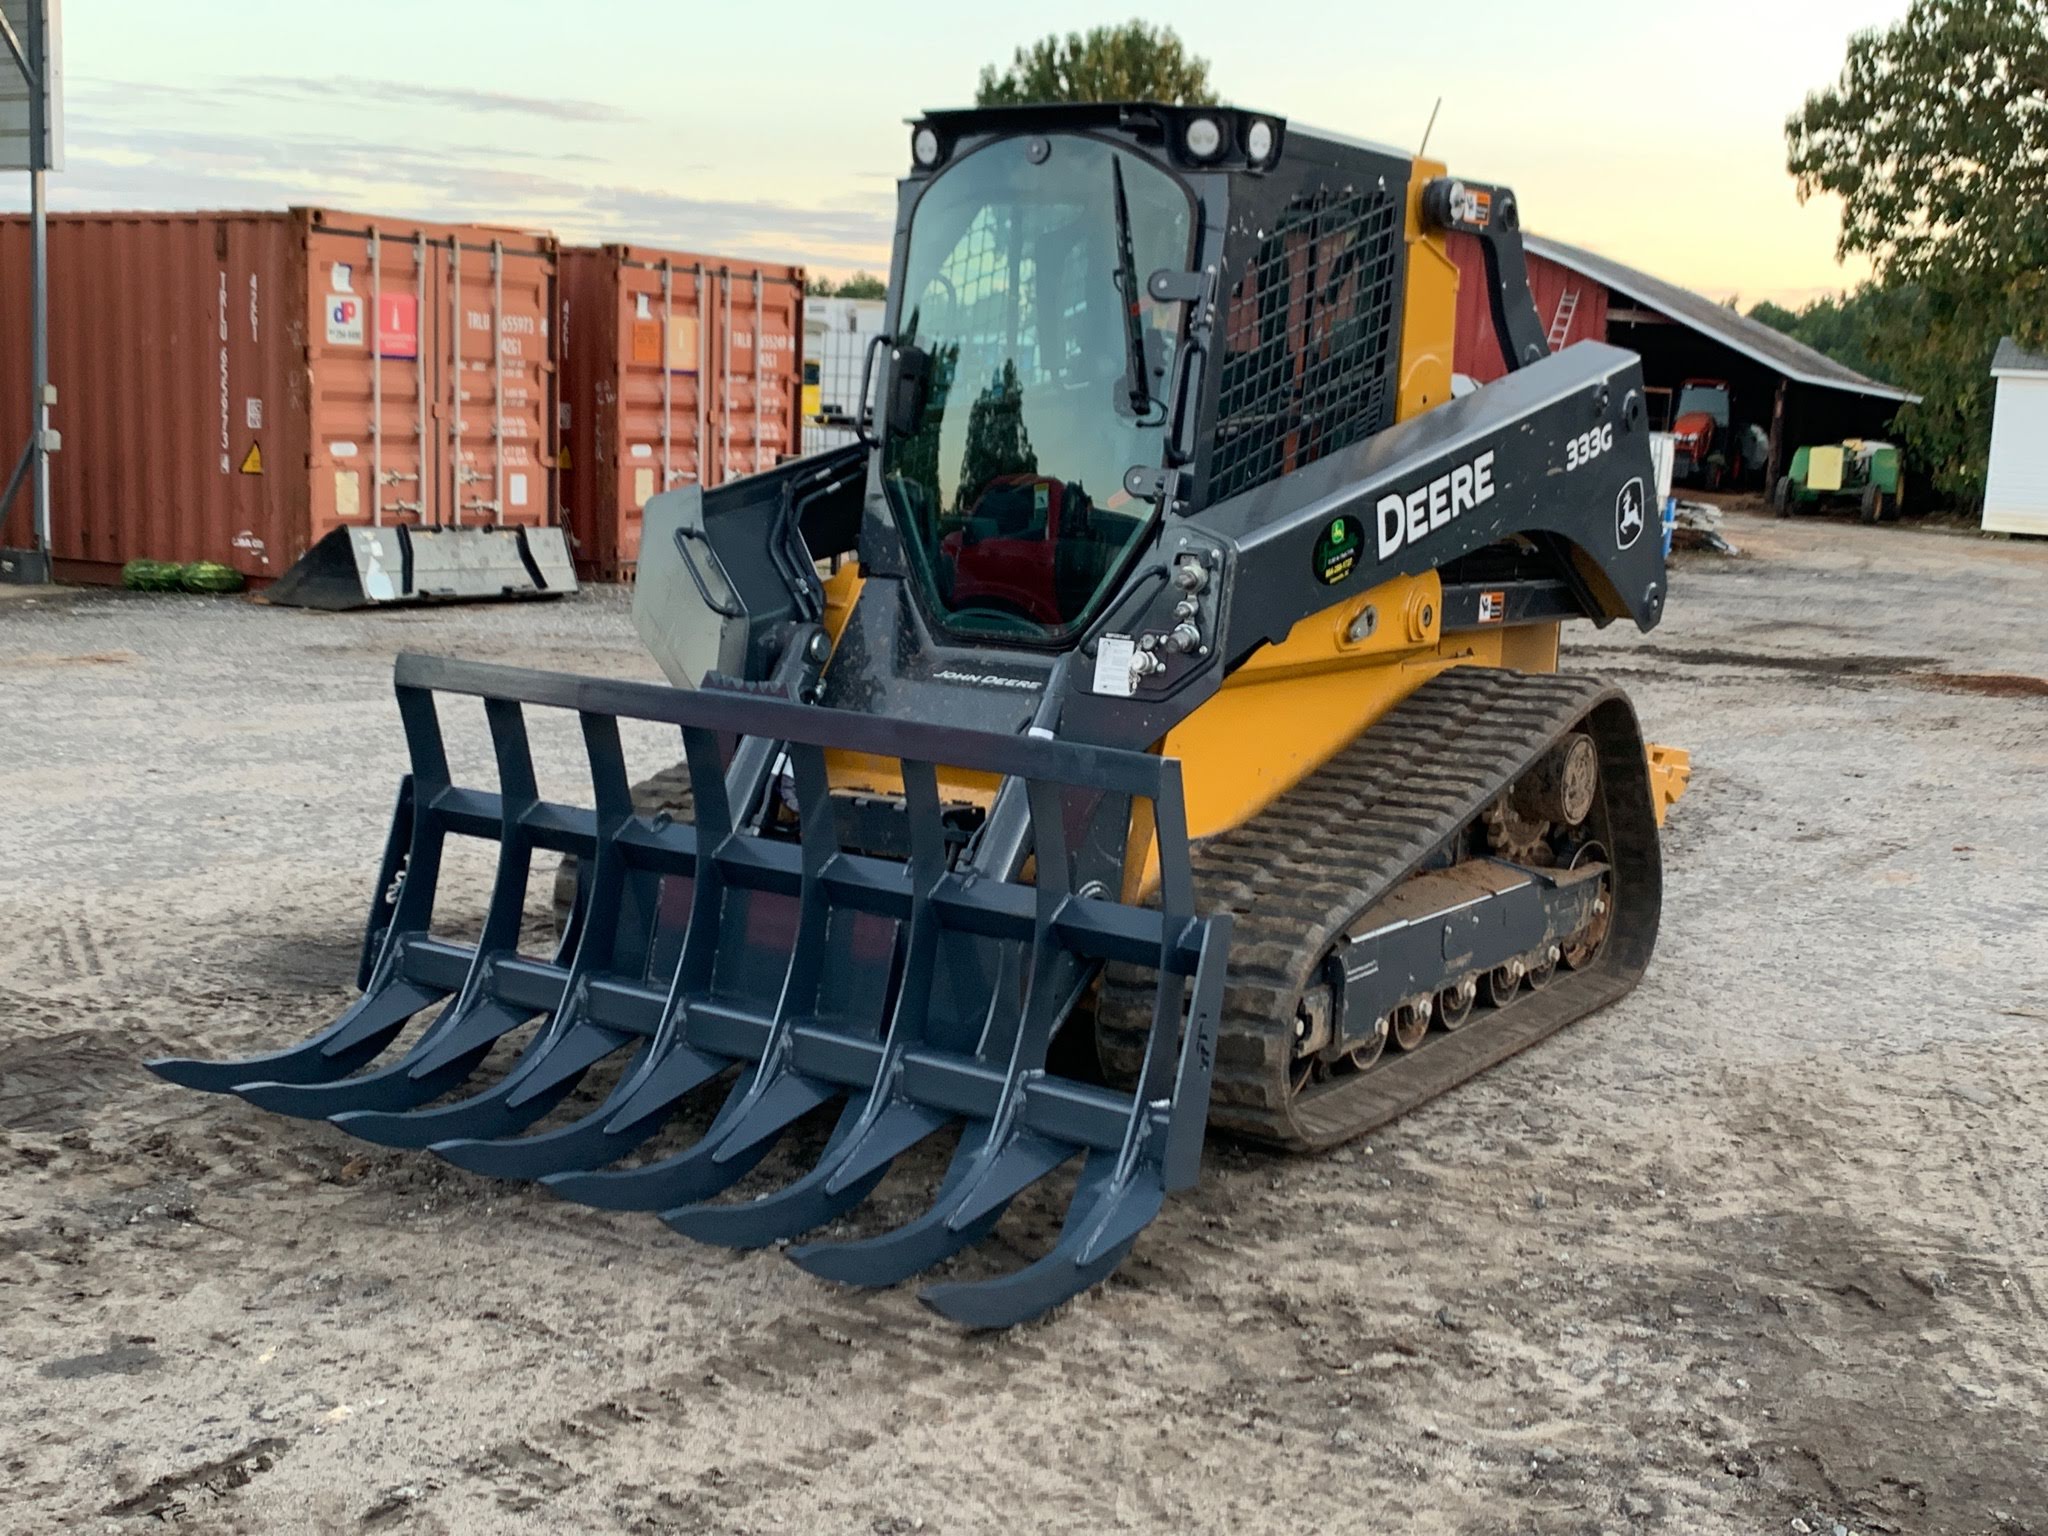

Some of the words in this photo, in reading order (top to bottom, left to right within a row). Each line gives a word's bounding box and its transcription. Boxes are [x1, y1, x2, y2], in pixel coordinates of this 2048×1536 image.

[467, 311, 490, 331] TRLU
[501, 315, 534, 335] 655973
[1566, 422, 1613, 472] 333G
[1376, 449, 1495, 561] DEERE
[933, 670, 982, 682] JOHN
[980, 675, 1043, 690] DEERE
